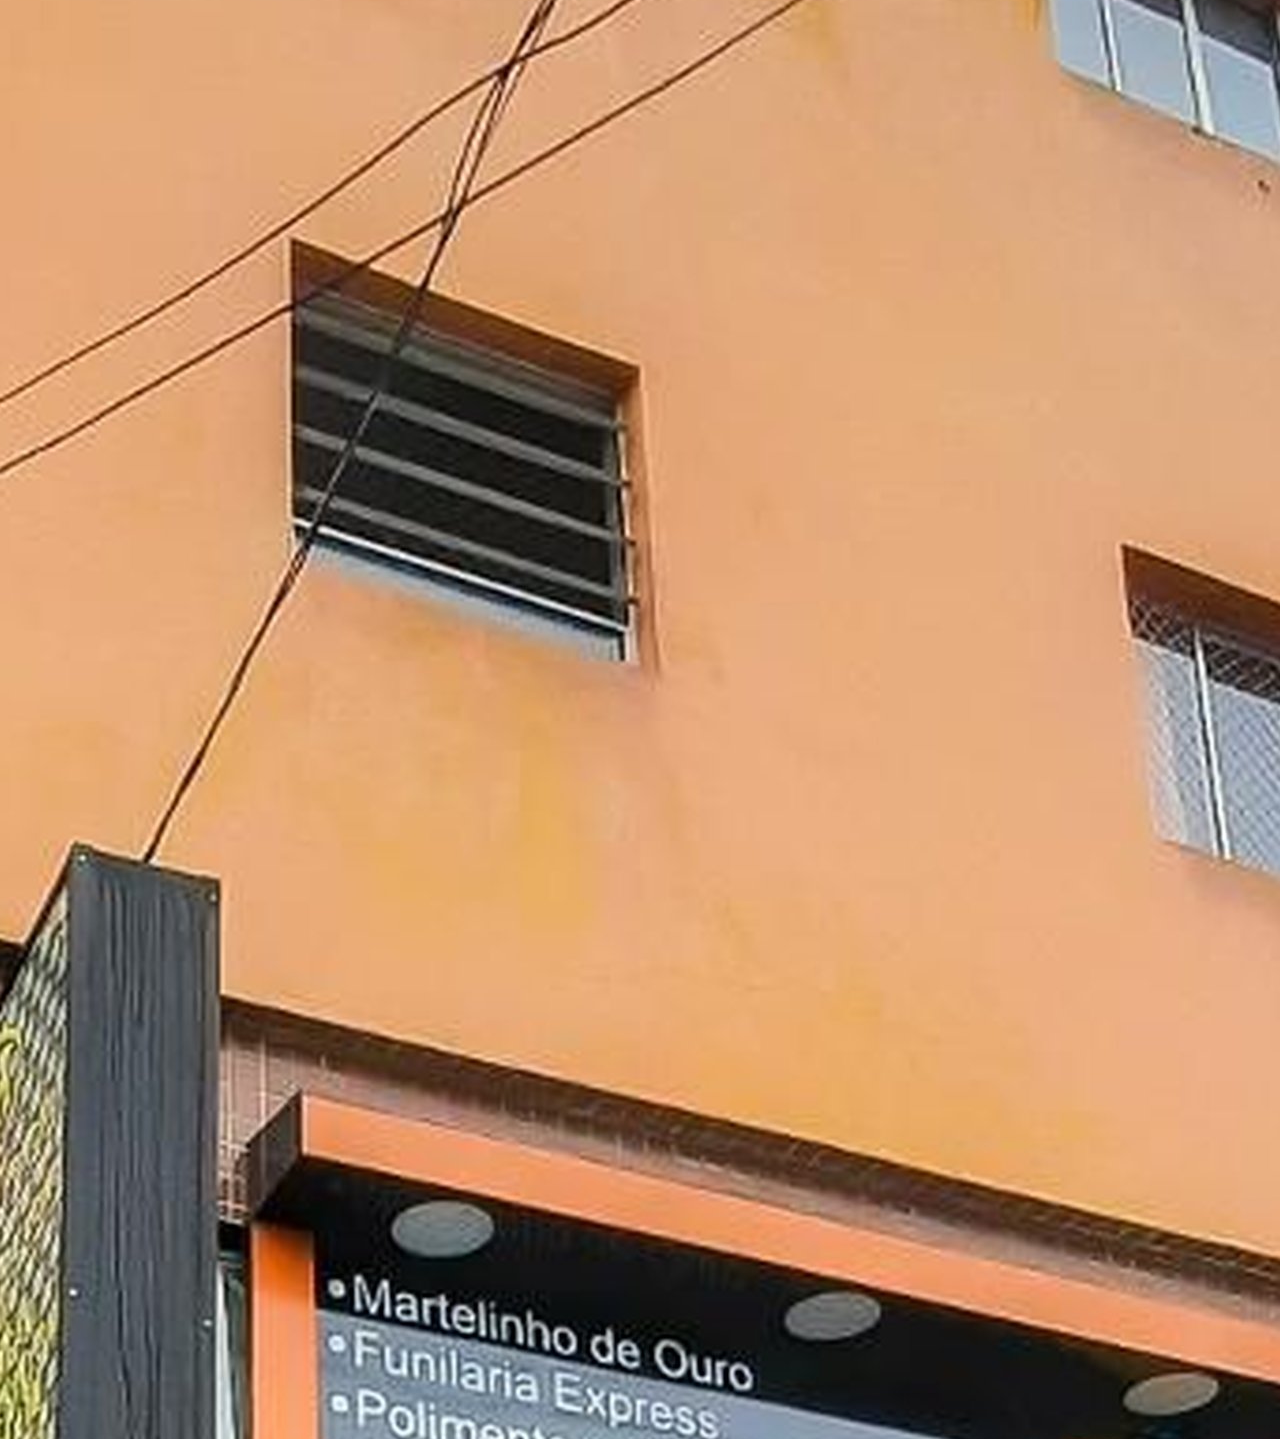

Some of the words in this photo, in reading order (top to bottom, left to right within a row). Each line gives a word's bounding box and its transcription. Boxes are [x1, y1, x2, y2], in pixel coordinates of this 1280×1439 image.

[352, 1275, 578, 1357] Martelinho
[589, 1327, 640, 1367] de
[652, 1339, 754, 1392] Ouro
[352, 1331, 540, 1403] Funilaria
